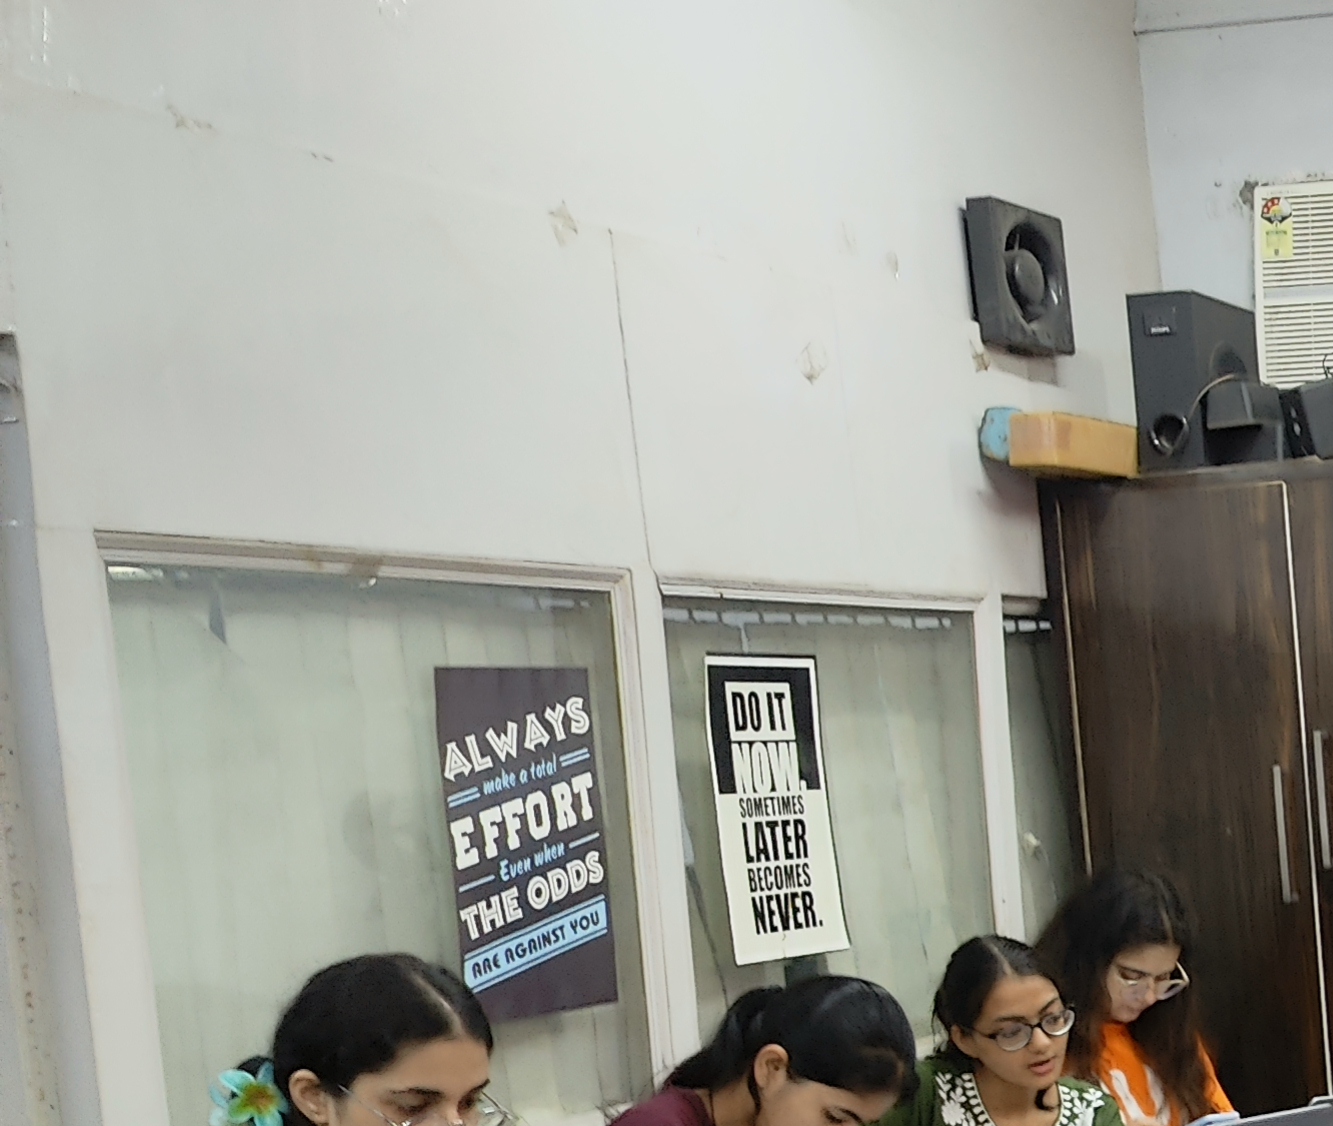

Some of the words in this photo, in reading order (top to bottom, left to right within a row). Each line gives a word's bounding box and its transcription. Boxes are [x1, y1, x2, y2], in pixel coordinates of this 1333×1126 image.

[730, 691, 762, 732] DO
[766, 691, 786, 732] IT
[443, 696, 590, 783] ALWAYS
[482, 773, 517, 796] make
[519, 769, 529, 785] a
[530, 753, 558, 780] total
[450, 772, 594, 871] EFFORT
[739, 795, 805, 819] SOMETIMES
[499, 853, 532, 883] Even
[533, 842, 565, 869] when
[741, 818, 809, 864] LATER
[459, 885, 524, 941] THE
[526, 851, 604, 912] ODDS
[747, 862, 812, 893] BECOMES
[751, 891, 824, 936] NEVER.
[471, 956, 501, 980] ARE
[504, 923, 567, 965] AGAINST
[569, 907, 601, 936] YOU
